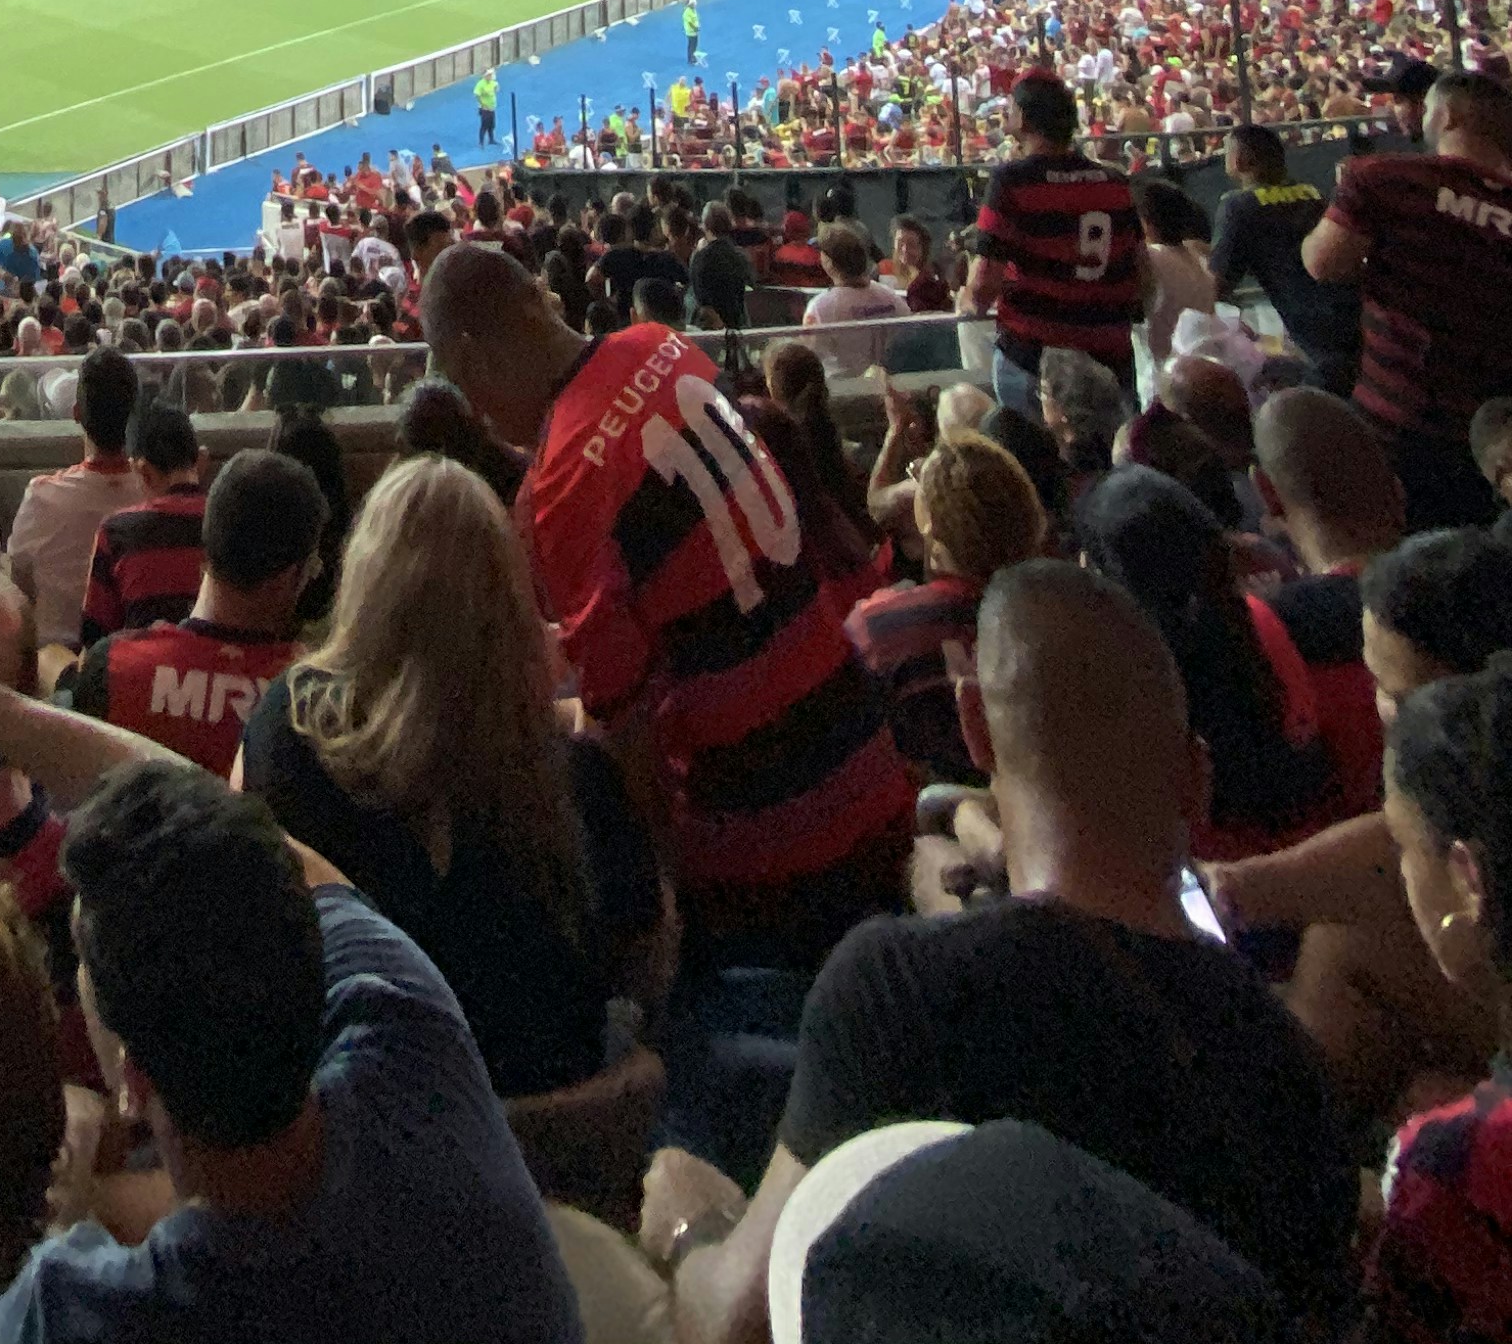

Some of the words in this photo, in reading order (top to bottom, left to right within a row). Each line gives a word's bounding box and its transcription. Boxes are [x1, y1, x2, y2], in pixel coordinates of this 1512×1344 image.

[1074, 211, 1112, 281] 9
[583, 331, 689, 467] PEUGEOT
[640, 374, 801, 615] 10
[150, 664, 269, 724] MR
